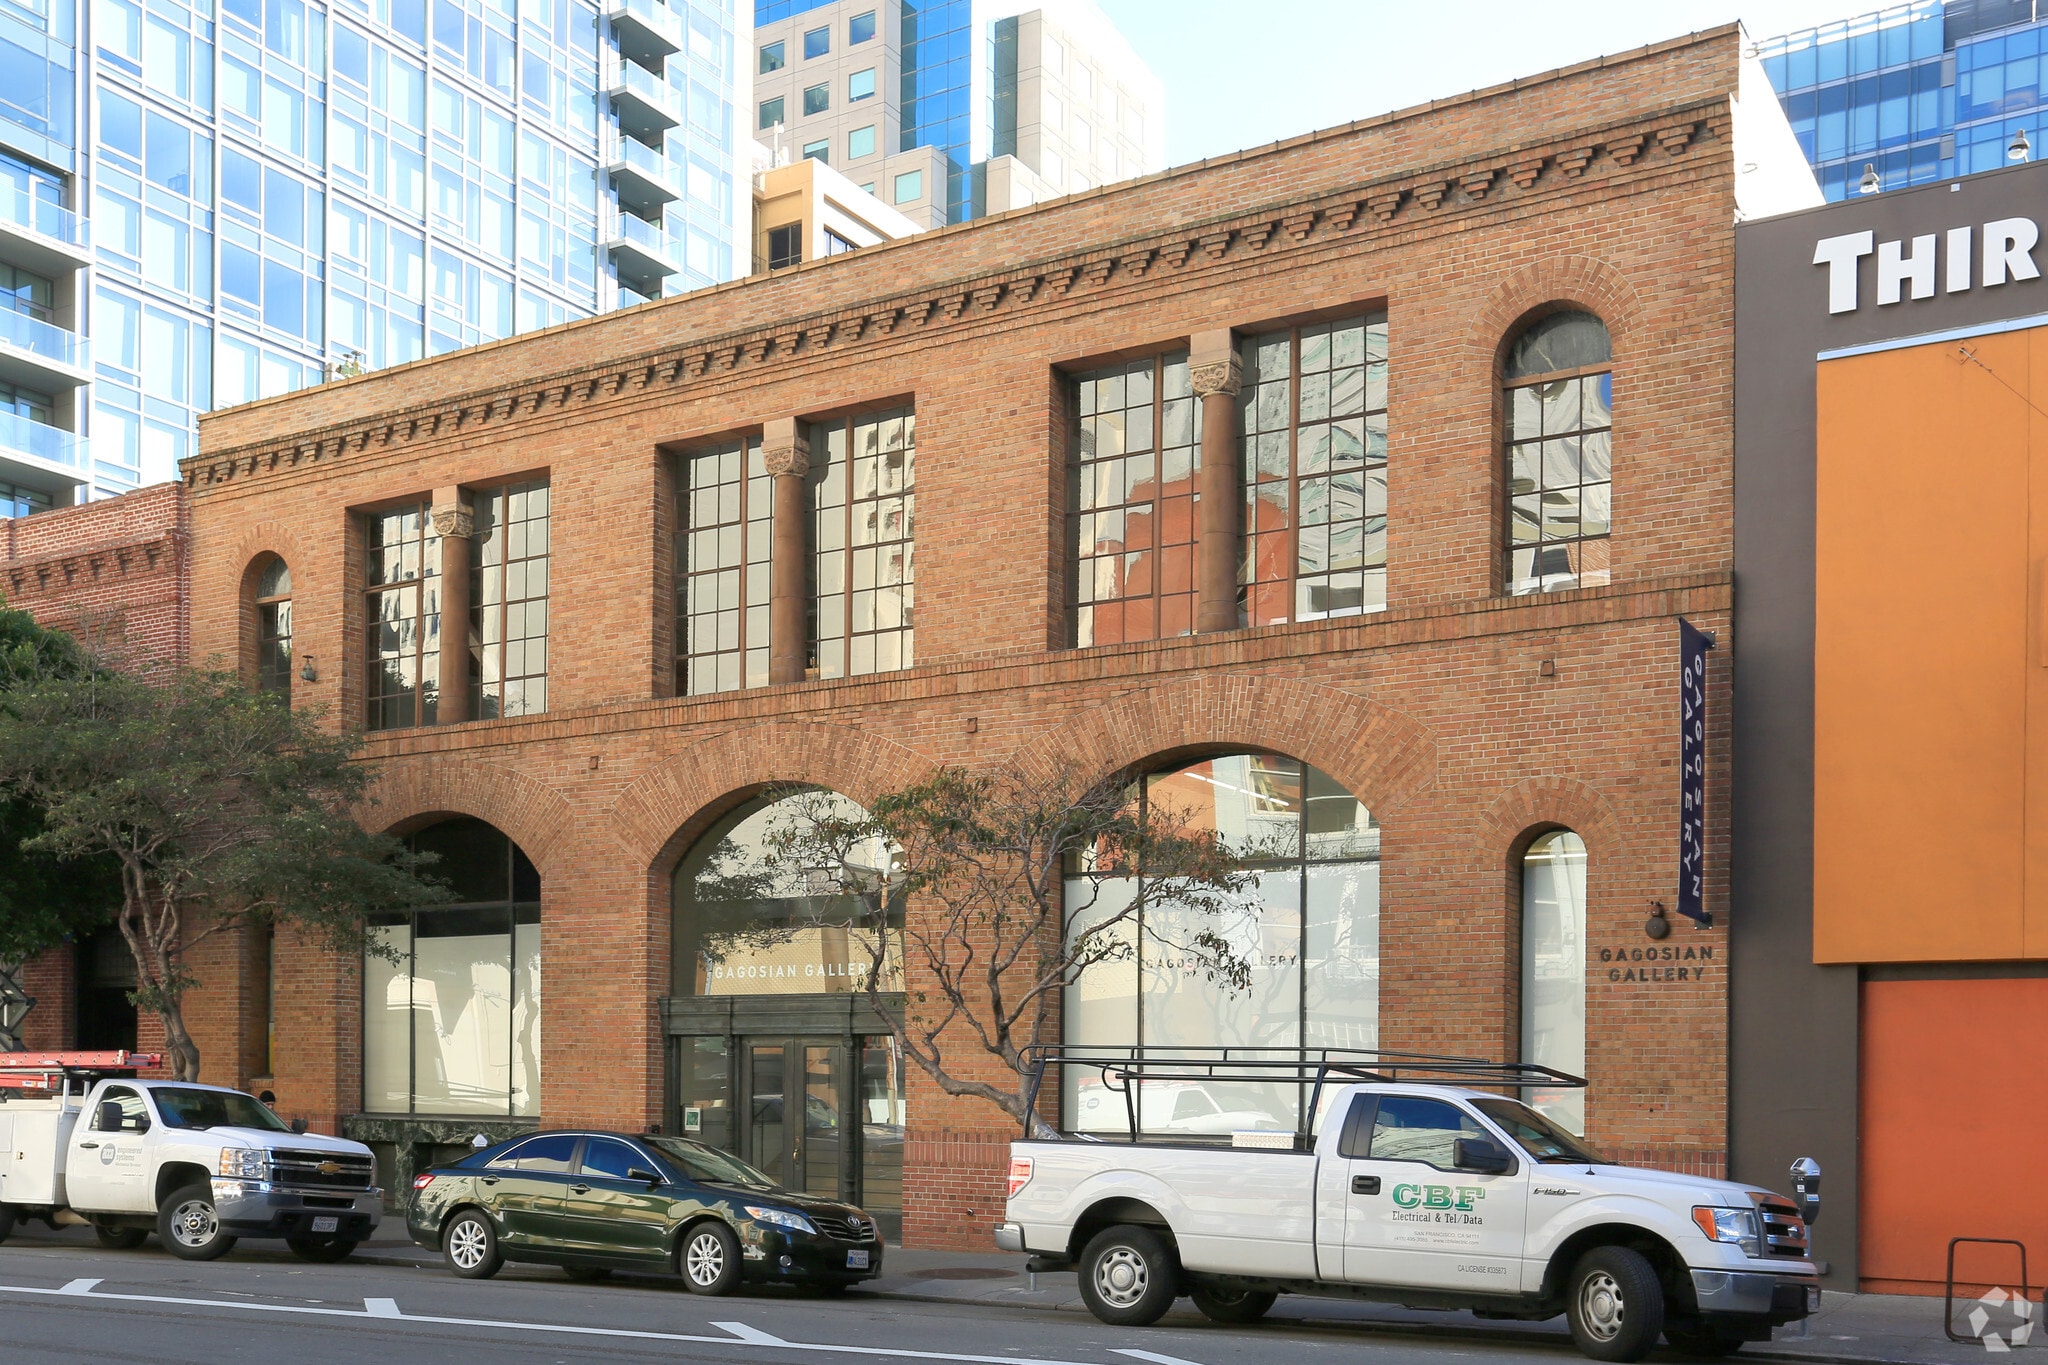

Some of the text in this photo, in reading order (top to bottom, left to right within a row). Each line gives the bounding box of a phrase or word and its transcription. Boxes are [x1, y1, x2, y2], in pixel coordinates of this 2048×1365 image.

[1684, 666, 1693, 873] GALLERY
[1693, 654, 1703, 898] GAGOSIAN
[1600, 946, 1712, 962] GAGOSIAN
[715, 962, 876, 979] GAGOSIAN GALLER
[1609, 967, 1704, 982] GALLERY
[1392, 1183, 1486, 1212] CBF
[1392, 1211, 1483, 1225] Electrical & Tel/Data
